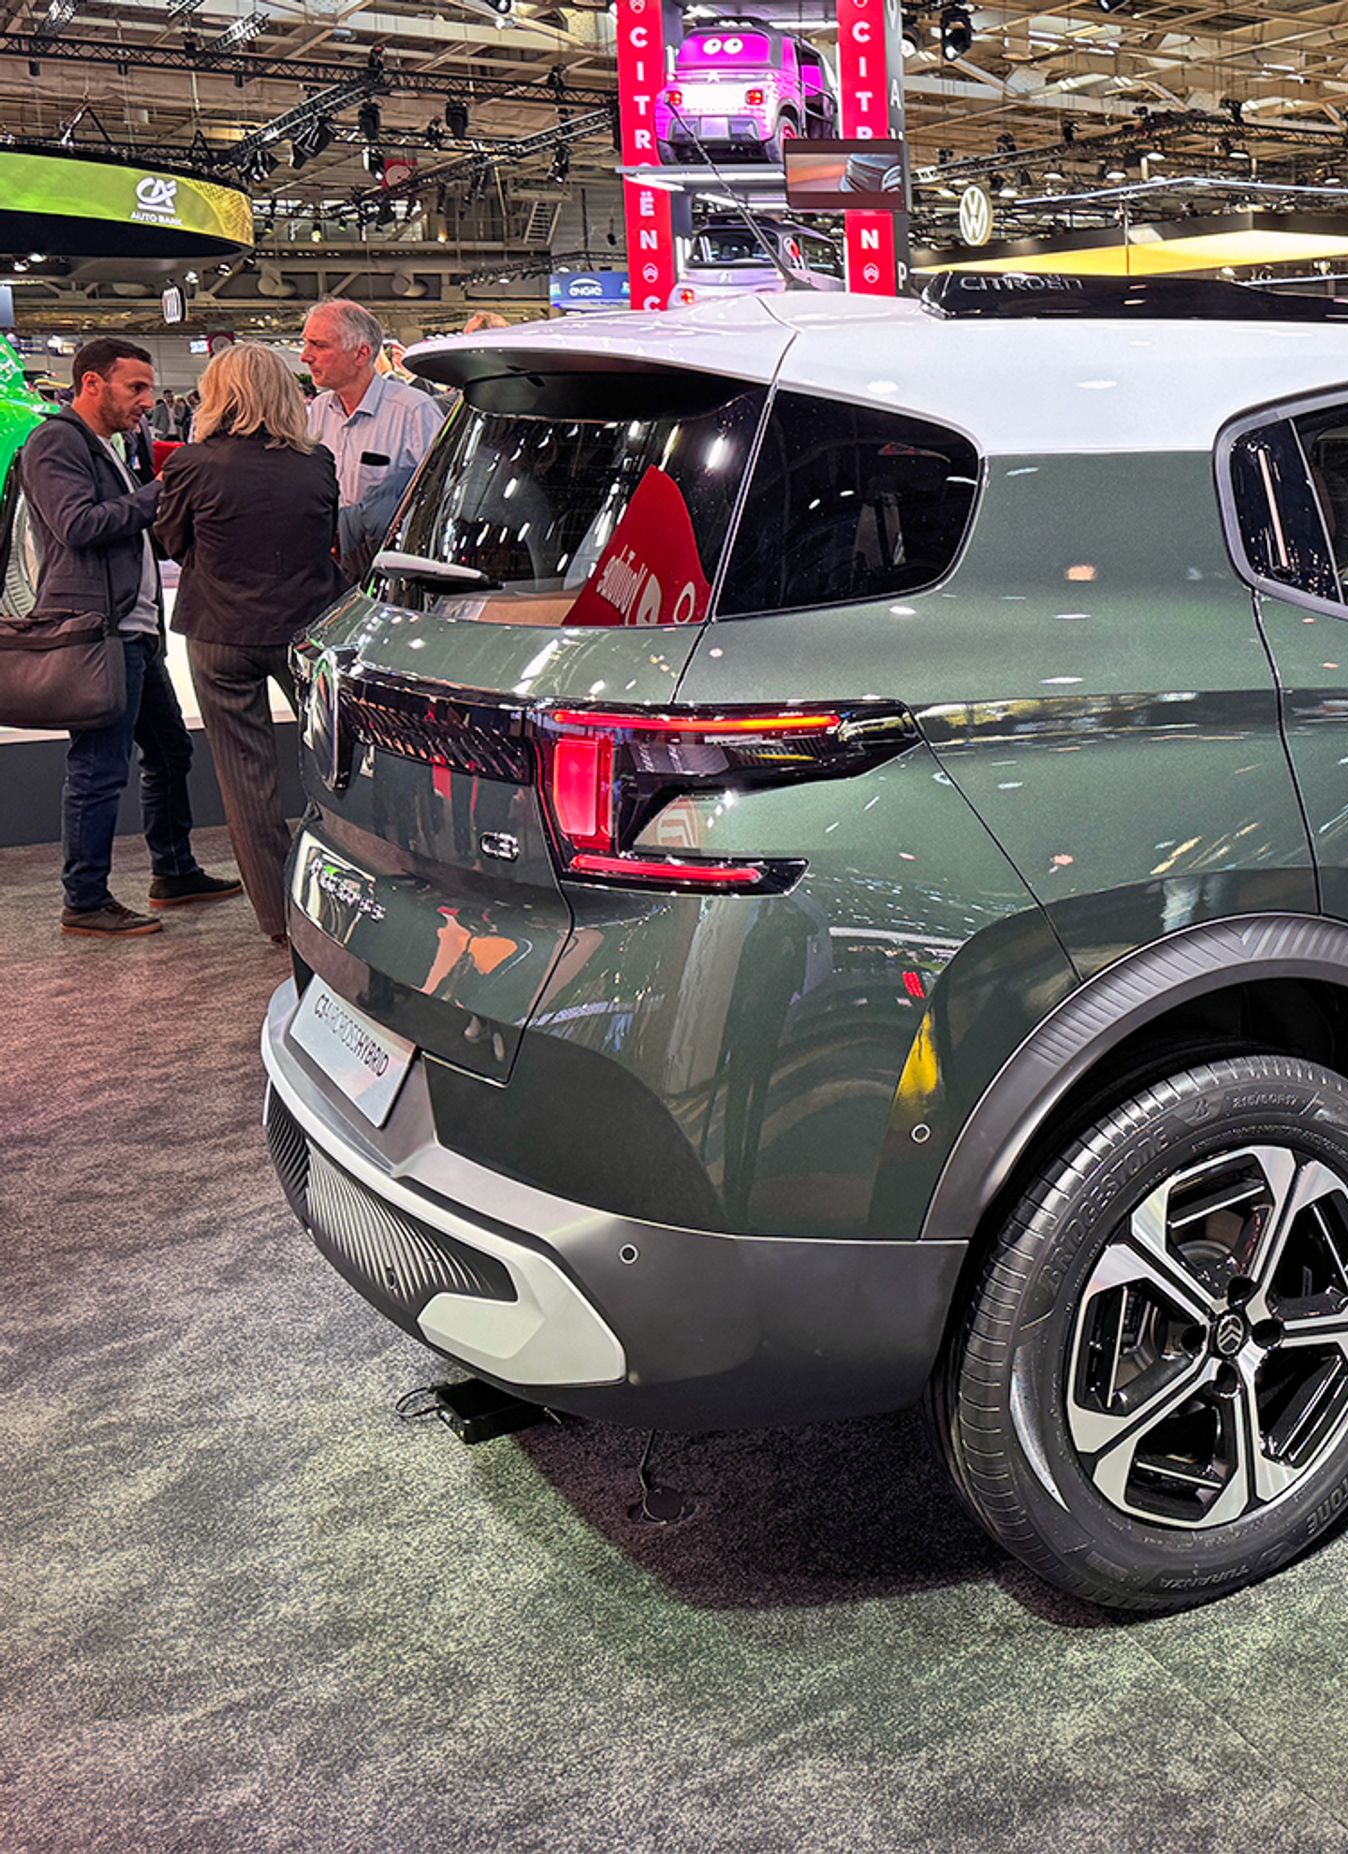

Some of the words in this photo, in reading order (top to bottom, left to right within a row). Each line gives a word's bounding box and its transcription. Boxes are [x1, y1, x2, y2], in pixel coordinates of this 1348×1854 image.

[629, 27, 658, 250] CITRËN
[131, 211, 157, 223] AUTO
[158, 213, 183, 226] BANK
[1159, 1564, 1249, 1589] TURANZA
